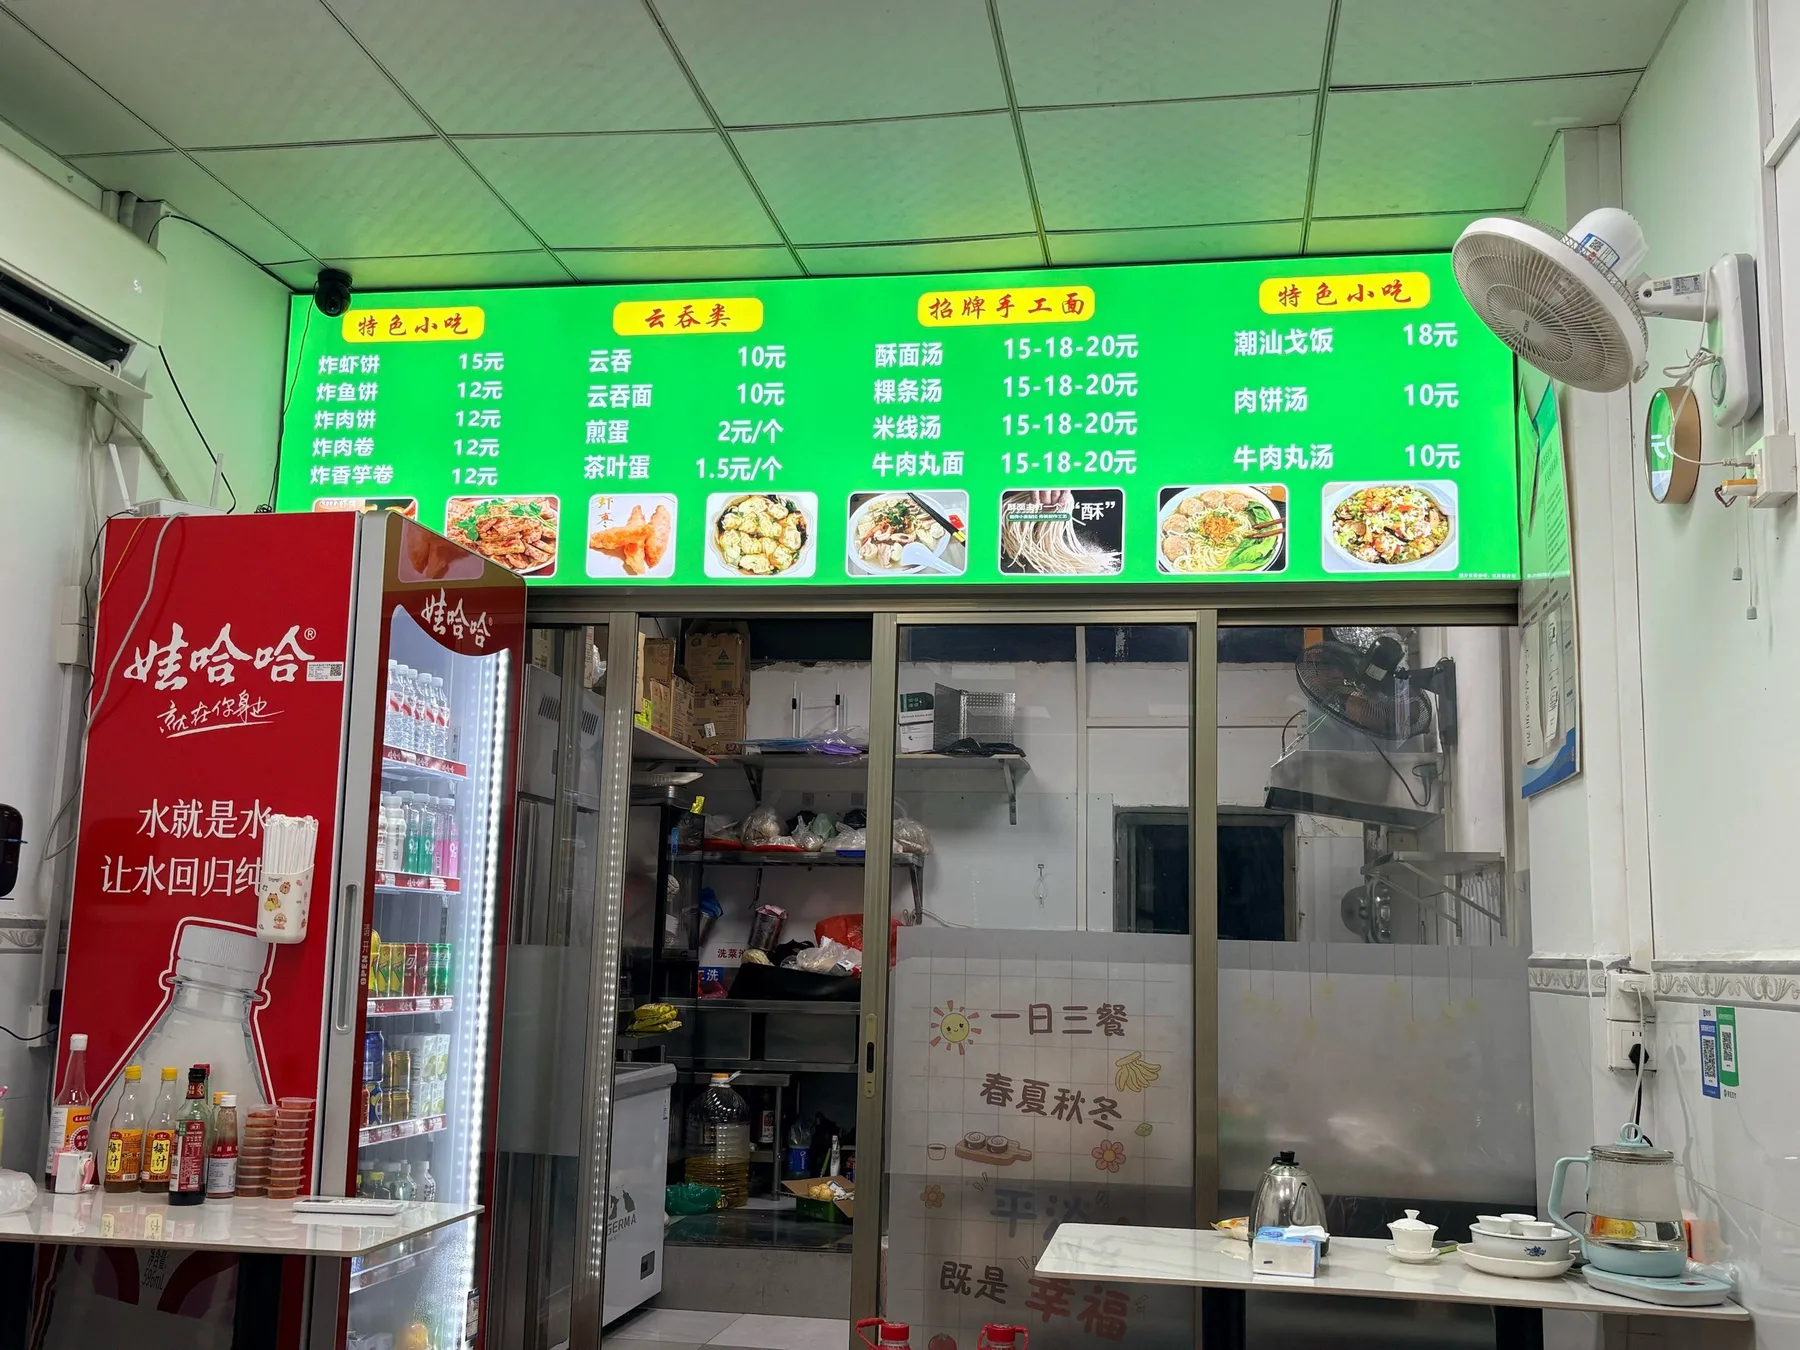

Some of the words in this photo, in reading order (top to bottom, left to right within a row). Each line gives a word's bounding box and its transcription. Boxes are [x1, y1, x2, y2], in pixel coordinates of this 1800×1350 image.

[928, 292, 1085, 320] 招牌手工面
[1278, 279, 1412, 308] 特色小吃
[358, 312, 468, 337] 特色小吃
[644, 303, 731, 329] 云吞类
[875, 341, 944, 368] 酥面汤
[1004, 334, 1139, 360] 15-18-20元
[1234, 327, 1334, 357] 潮汕戈饭
[1403, 322, 1458, 348] 18元
[318, 354, 380, 375] 炸虾饼
[459, 352, 505, 371] 15元
[589, 348, 632, 373] 云吞
[738, 345, 786, 369] 10元
[316, 382, 378, 402] 炸鱼饼
[457, 380, 503, 400] 12元
[587, 383, 653, 409] 云吞面
[737, 382, 785, 406] 10元
[873, 378, 943, 405] 粿条汤
[1003, 372, 1138, 398] 15-18-20元
[1234, 386, 1308, 414] 肉饼汤
[1404, 382, 1459, 408] 10元
[314, 409, 376, 430] 炸肉饼
[455, 409, 502, 429] 12元
[585, 419, 629, 444] 煎蛋
[718, 418, 784, 444] 2元/个
[872, 414, 941, 441] 米线汤
[1002, 411, 1138, 436] 15-18-20元
[312, 437, 375, 458] 炸肉卷
[454, 438, 500, 457] 12元
[1233, 443, 1334, 472] 牛肉丸汤
[1405, 443, 1461, 469] 10元
[452, 467, 498, 487] 12元
[583, 454, 650, 480] 茶叶蛋
[696, 455, 783, 481] 1.5元/个
[871, 450, 965, 478] 牛肉丸面
[1001, 449, 1137, 475] 15-18-20元
[421, 586, 491, 648] 娃哈哈
[123, 622, 316, 691] 娃哈哈
[136, 798, 272, 840] 水就是水
[360, 954, 369, 986] OPEN
[990, 1001, 1130, 1037] 一日三餐
[979, 1072, 1123, 1132] 春夏秋冬
[939, 1259, 1009, 1305] 既是
[1024, 1276, 1131, 1343] 幸福
